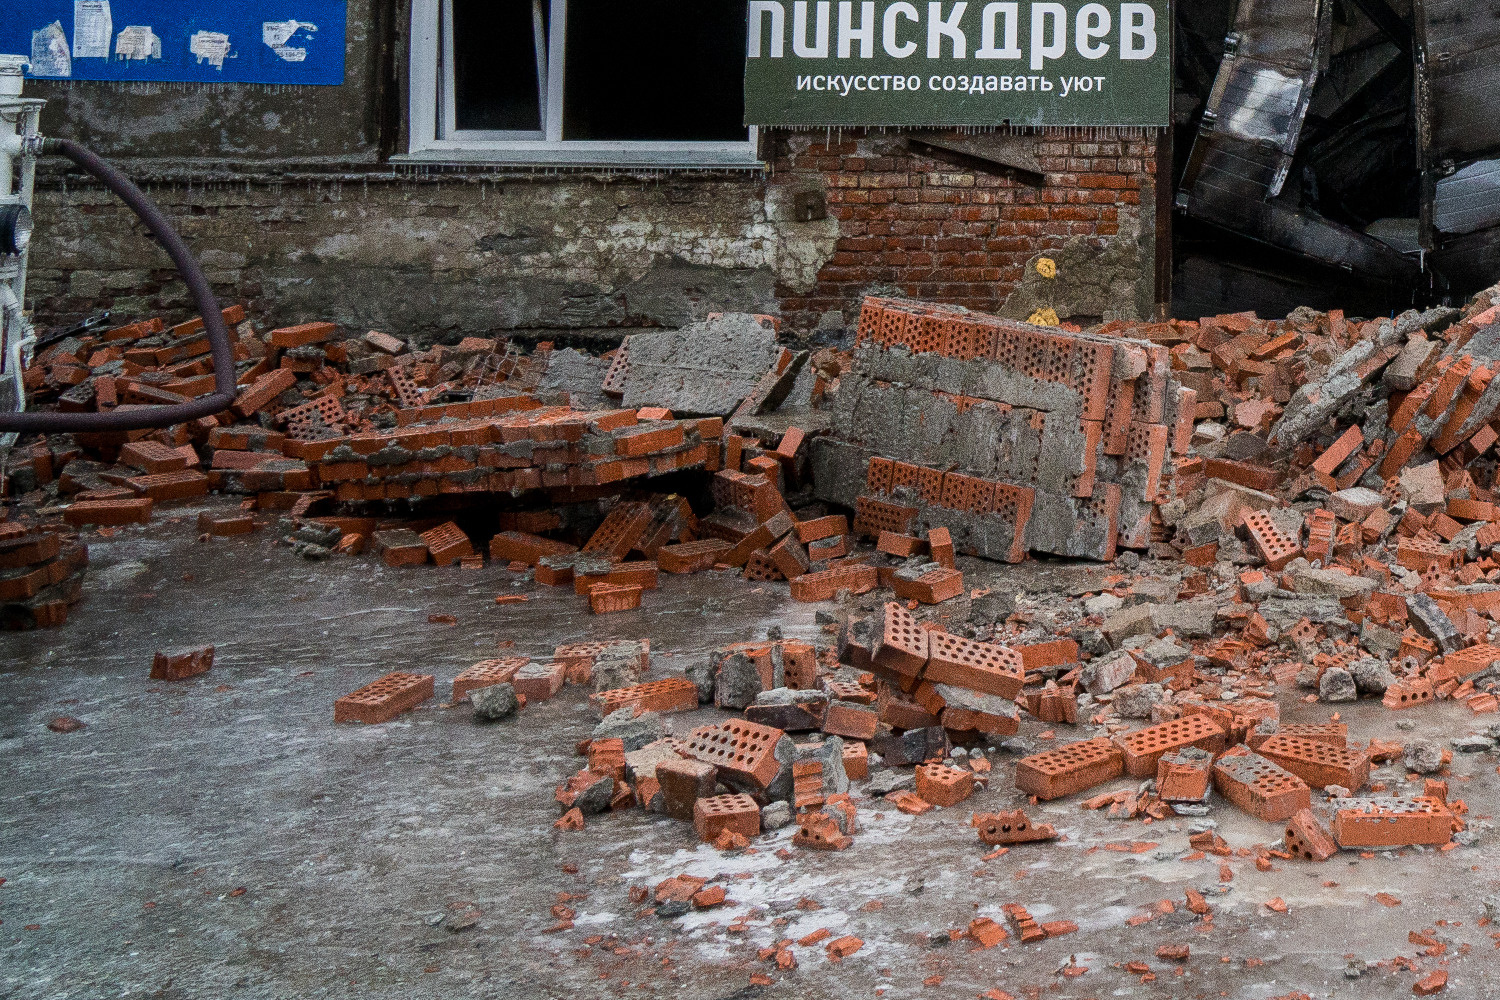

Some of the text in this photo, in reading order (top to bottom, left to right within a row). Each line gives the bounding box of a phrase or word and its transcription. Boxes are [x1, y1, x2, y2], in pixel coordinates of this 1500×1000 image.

[797, 73, 1105, 97] искусство создавать уют
